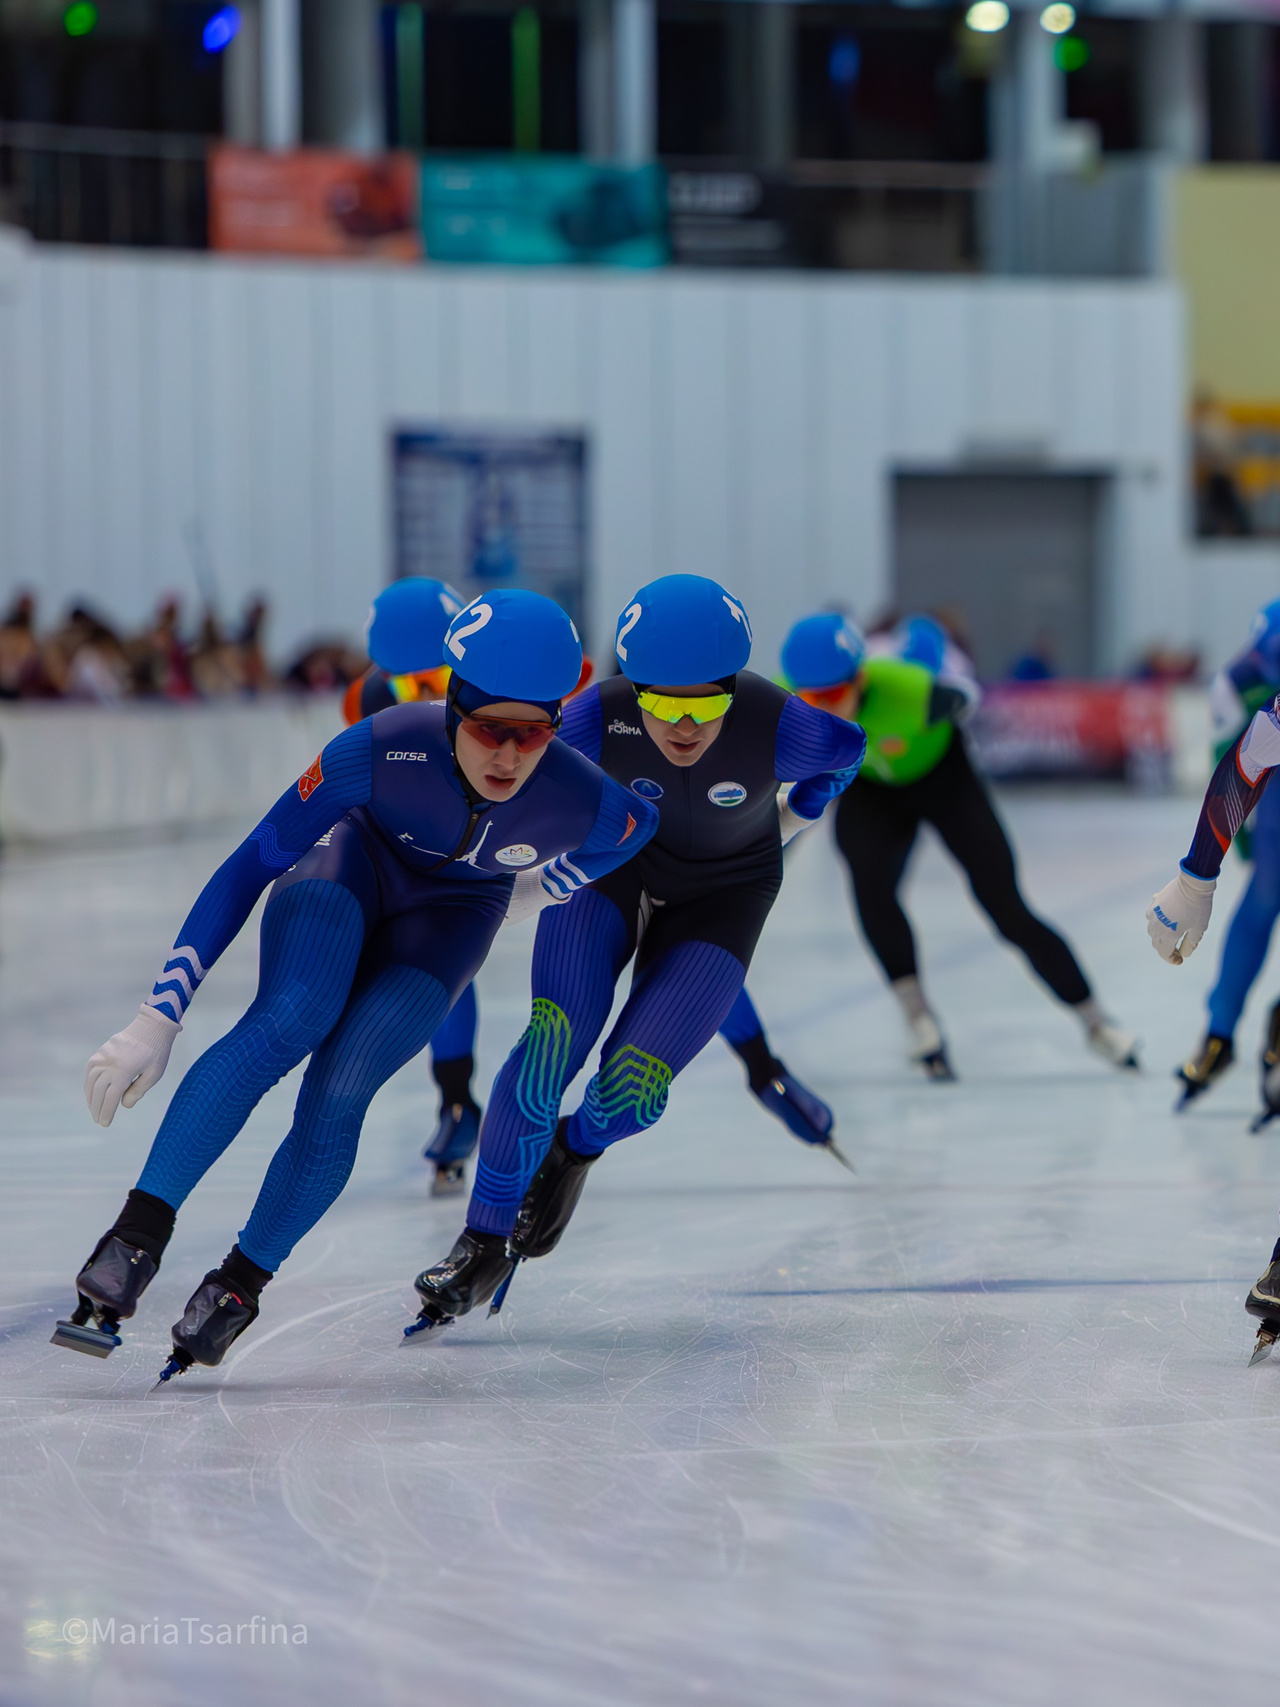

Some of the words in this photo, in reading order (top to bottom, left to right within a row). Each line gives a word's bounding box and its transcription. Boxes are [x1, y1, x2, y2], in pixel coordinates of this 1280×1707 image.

[444, 595, 493, 662] 2
[616, 598, 642, 662] 2
[608, 724, 642, 736] FORMA
[386, 751, 428, 762] corsa
